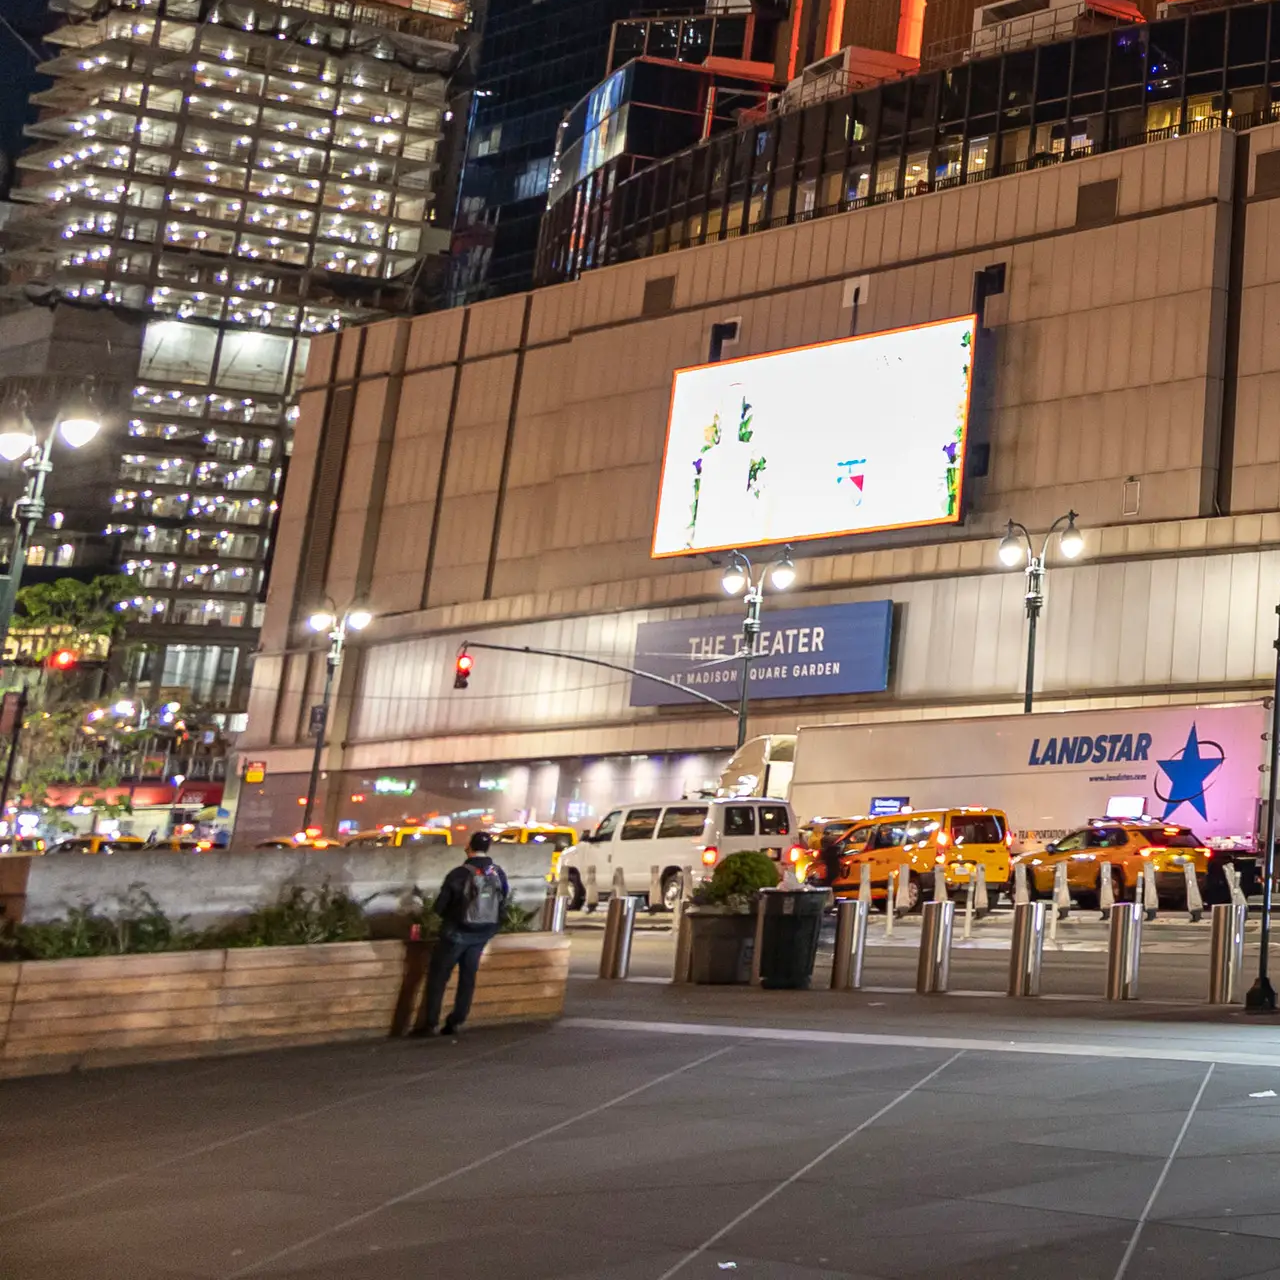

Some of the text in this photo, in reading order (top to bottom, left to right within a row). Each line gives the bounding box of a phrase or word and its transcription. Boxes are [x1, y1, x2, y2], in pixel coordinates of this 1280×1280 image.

[688, 635, 726, 661] THE
[686, 670, 738, 685] MADISON
[750, 665, 788, 681] QUARE
[792, 661, 841, 678] GARDEN
[1028, 732, 1153, 767] LANDSTAR
